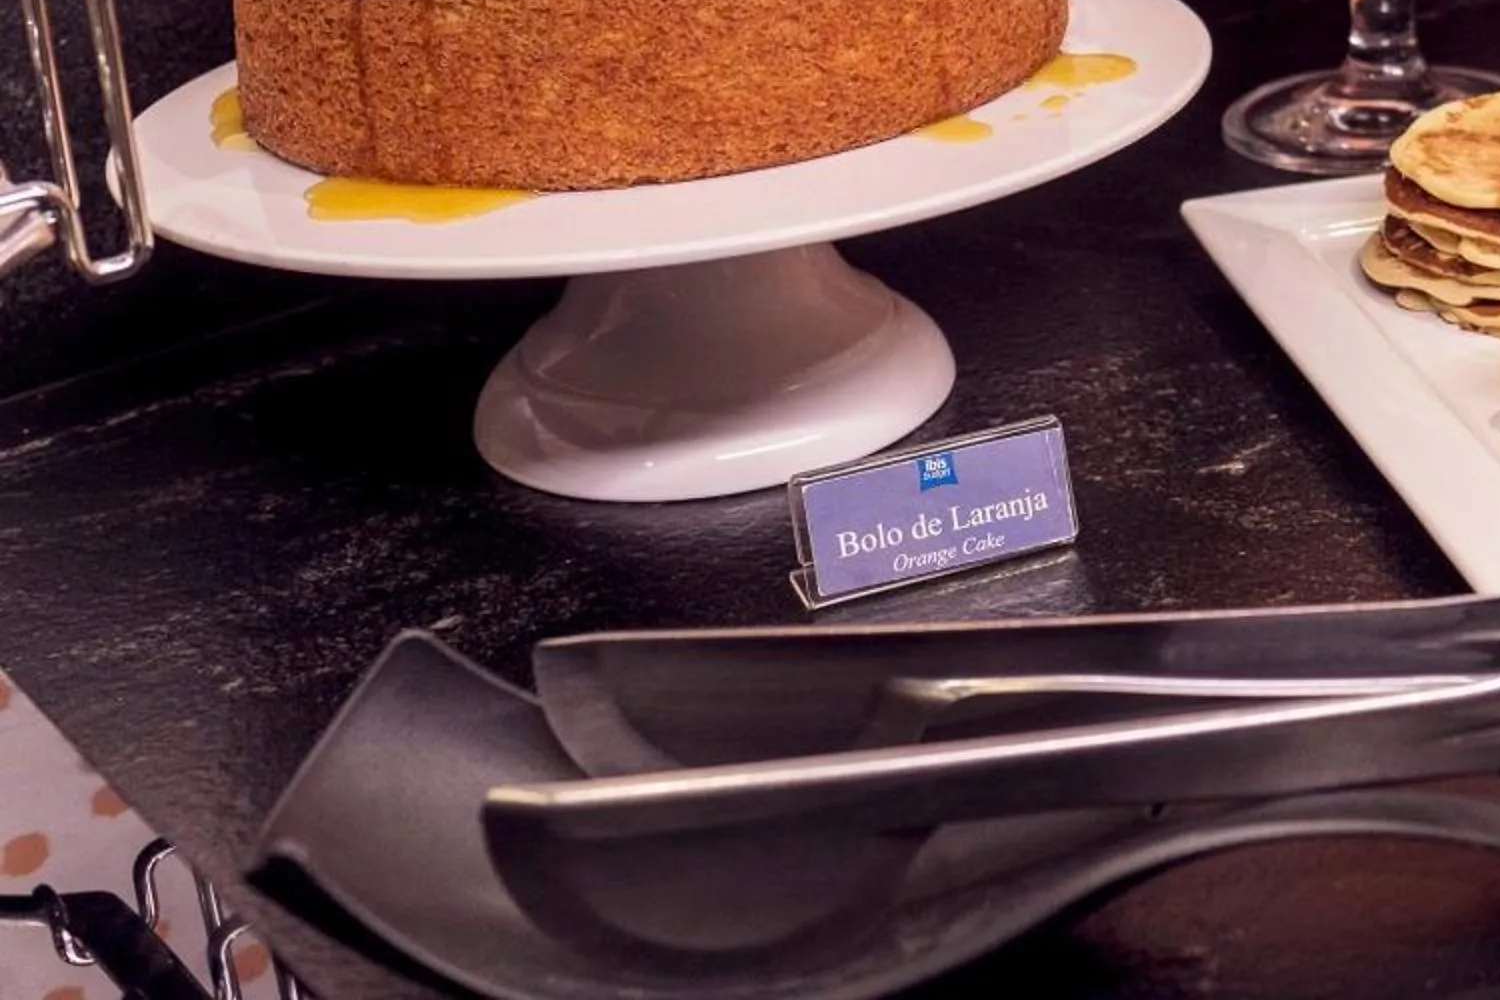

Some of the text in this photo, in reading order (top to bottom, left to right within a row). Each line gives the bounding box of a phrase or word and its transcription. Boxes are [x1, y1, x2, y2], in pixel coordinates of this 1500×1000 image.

[925, 457, 947, 471] ibis
[836, 488, 1049, 559] Bolo de Laranja
[893, 532, 1006, 573] Orange Cake
